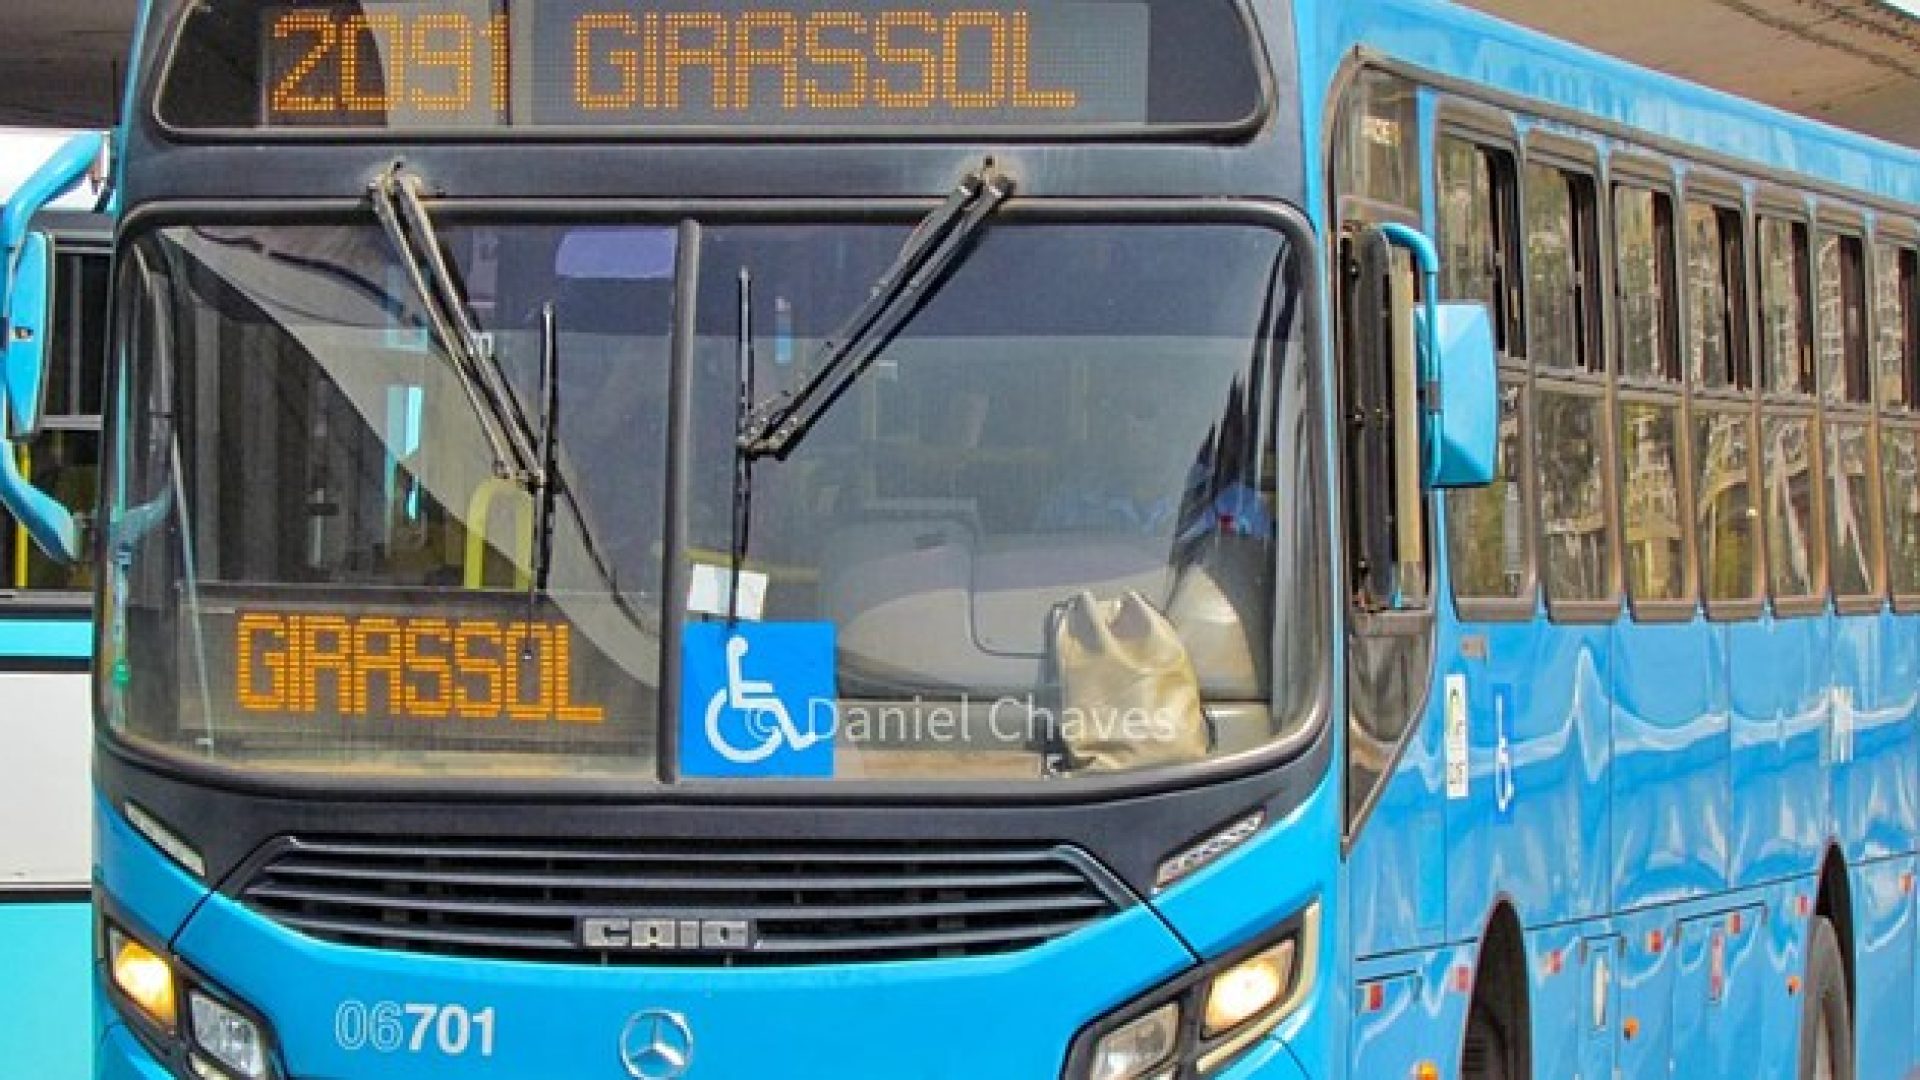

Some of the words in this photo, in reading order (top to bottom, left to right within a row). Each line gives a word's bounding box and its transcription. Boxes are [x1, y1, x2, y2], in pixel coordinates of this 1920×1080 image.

[272, 14, 507, 111] 2091
[575, 10, 1078, 110] GIRASSOL
[237, 612, 604, 721] GIRASSOL
[335, 1001, 494, 1056] 06701
